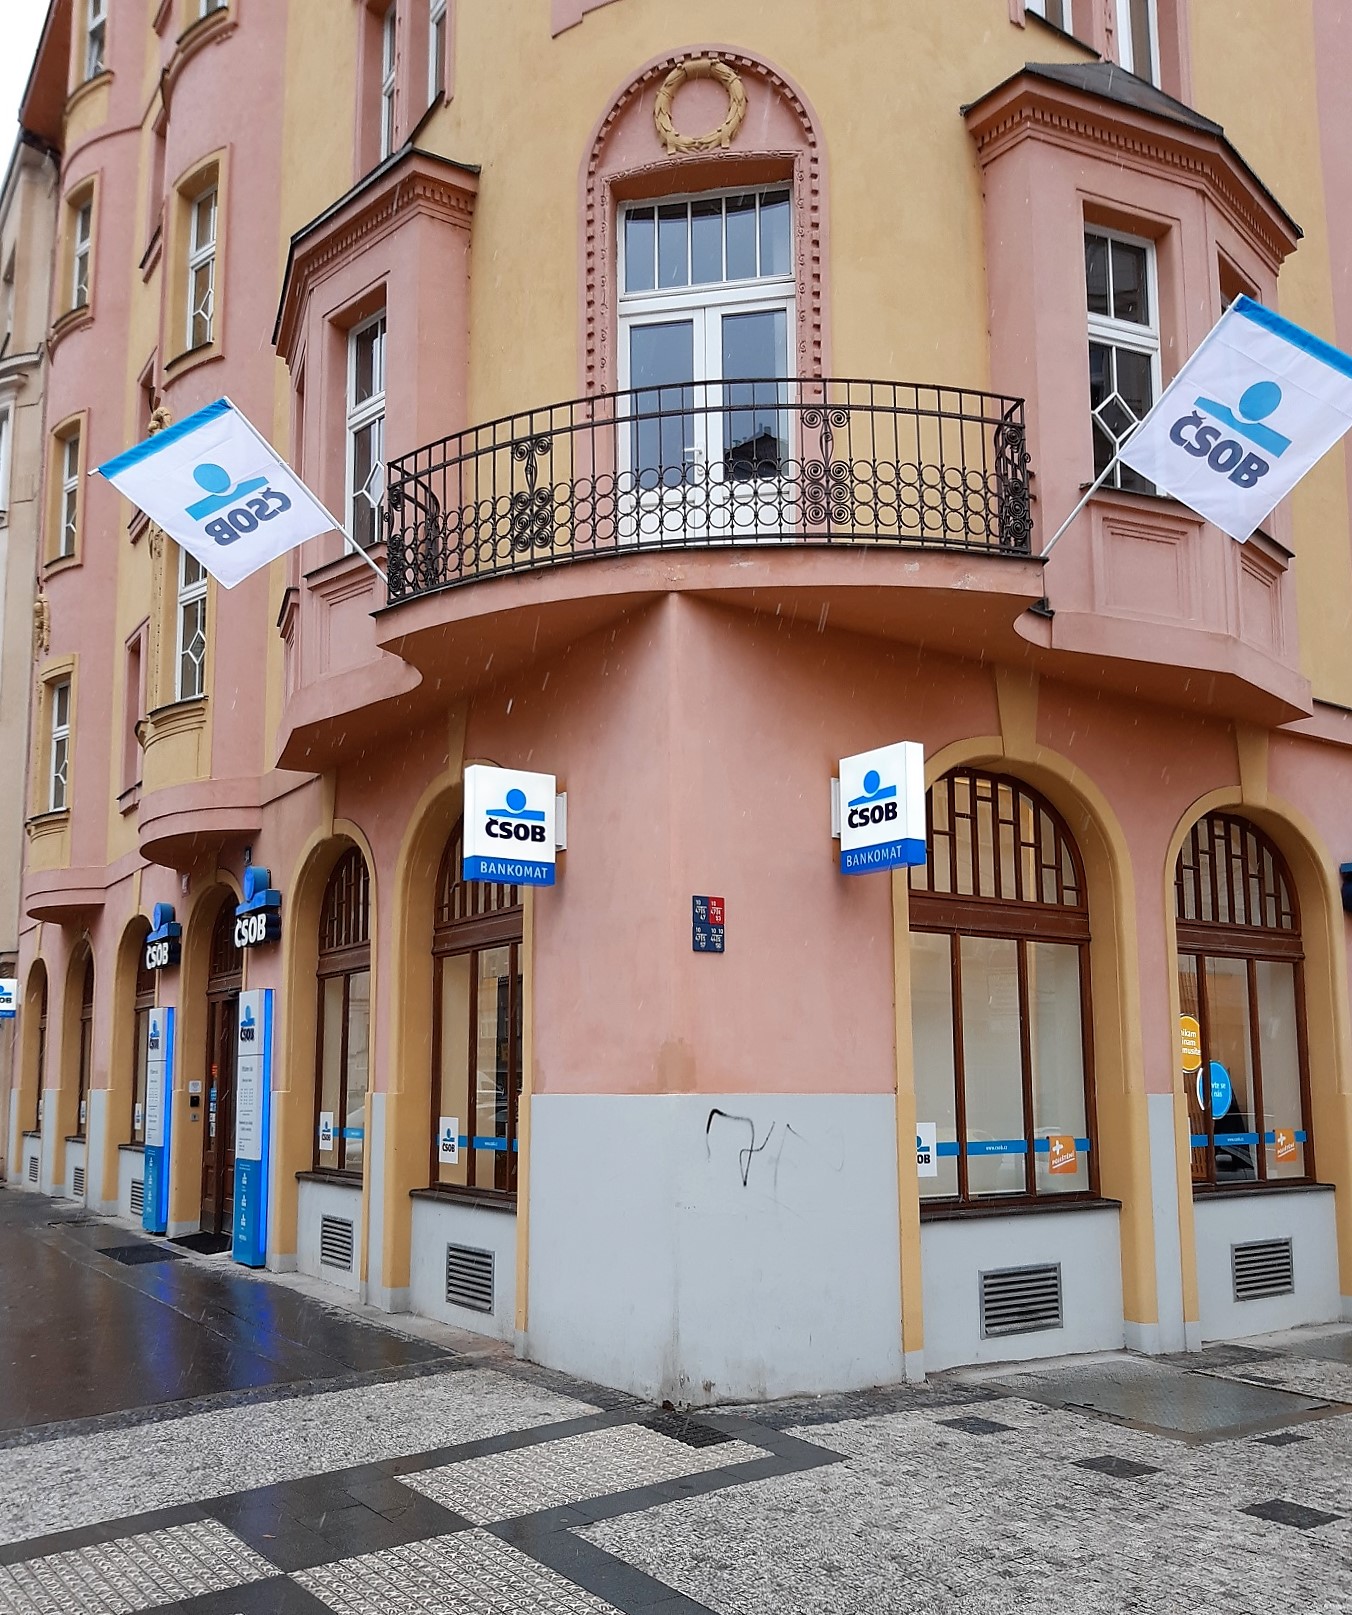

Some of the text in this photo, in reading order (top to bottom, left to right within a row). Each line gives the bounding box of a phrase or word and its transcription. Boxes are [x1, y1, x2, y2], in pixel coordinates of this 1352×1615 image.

[1169, 410, 1270, 489] ČSOB
[847, 802, 898, 829] ČSOB
[485, 817, 546, 843] ČSOB
[846, 845, 902, 867] BANKOMAT
[480, 861, 548, 879] BANKOMAT
[235, 913, 266, 948] ČSOB
[146, 942, 169, 970] ČSOB
[442, 1142, 455, 1153] ČSOB
